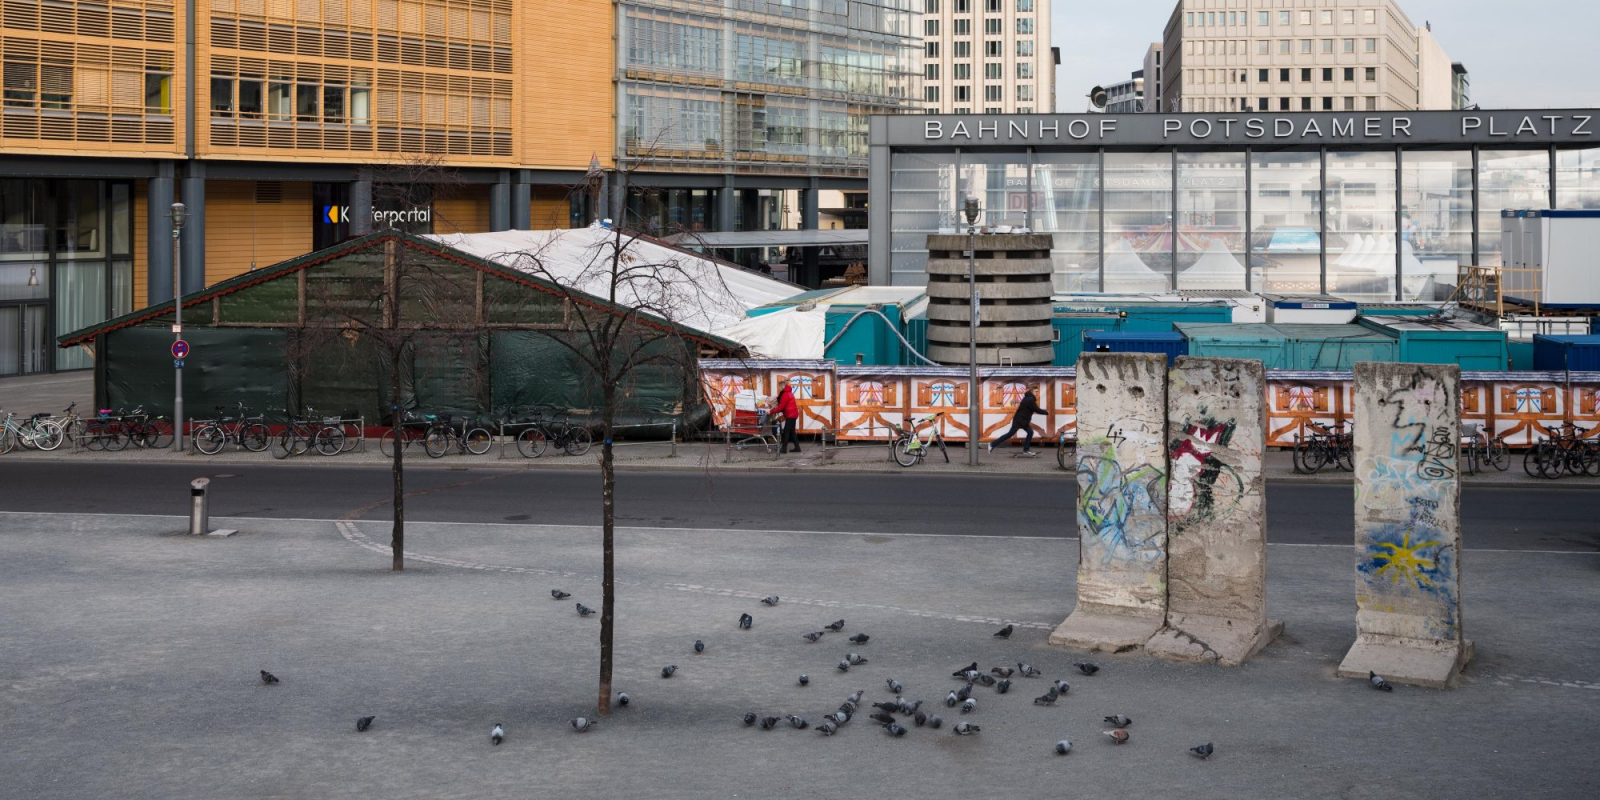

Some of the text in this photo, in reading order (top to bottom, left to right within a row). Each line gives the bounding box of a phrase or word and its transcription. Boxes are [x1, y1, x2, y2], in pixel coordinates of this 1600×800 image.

[923, 114, 1592, 139] BAHNHOF POTSDAMER PLATZ
[341, 205, 431, 226] Kferportal
